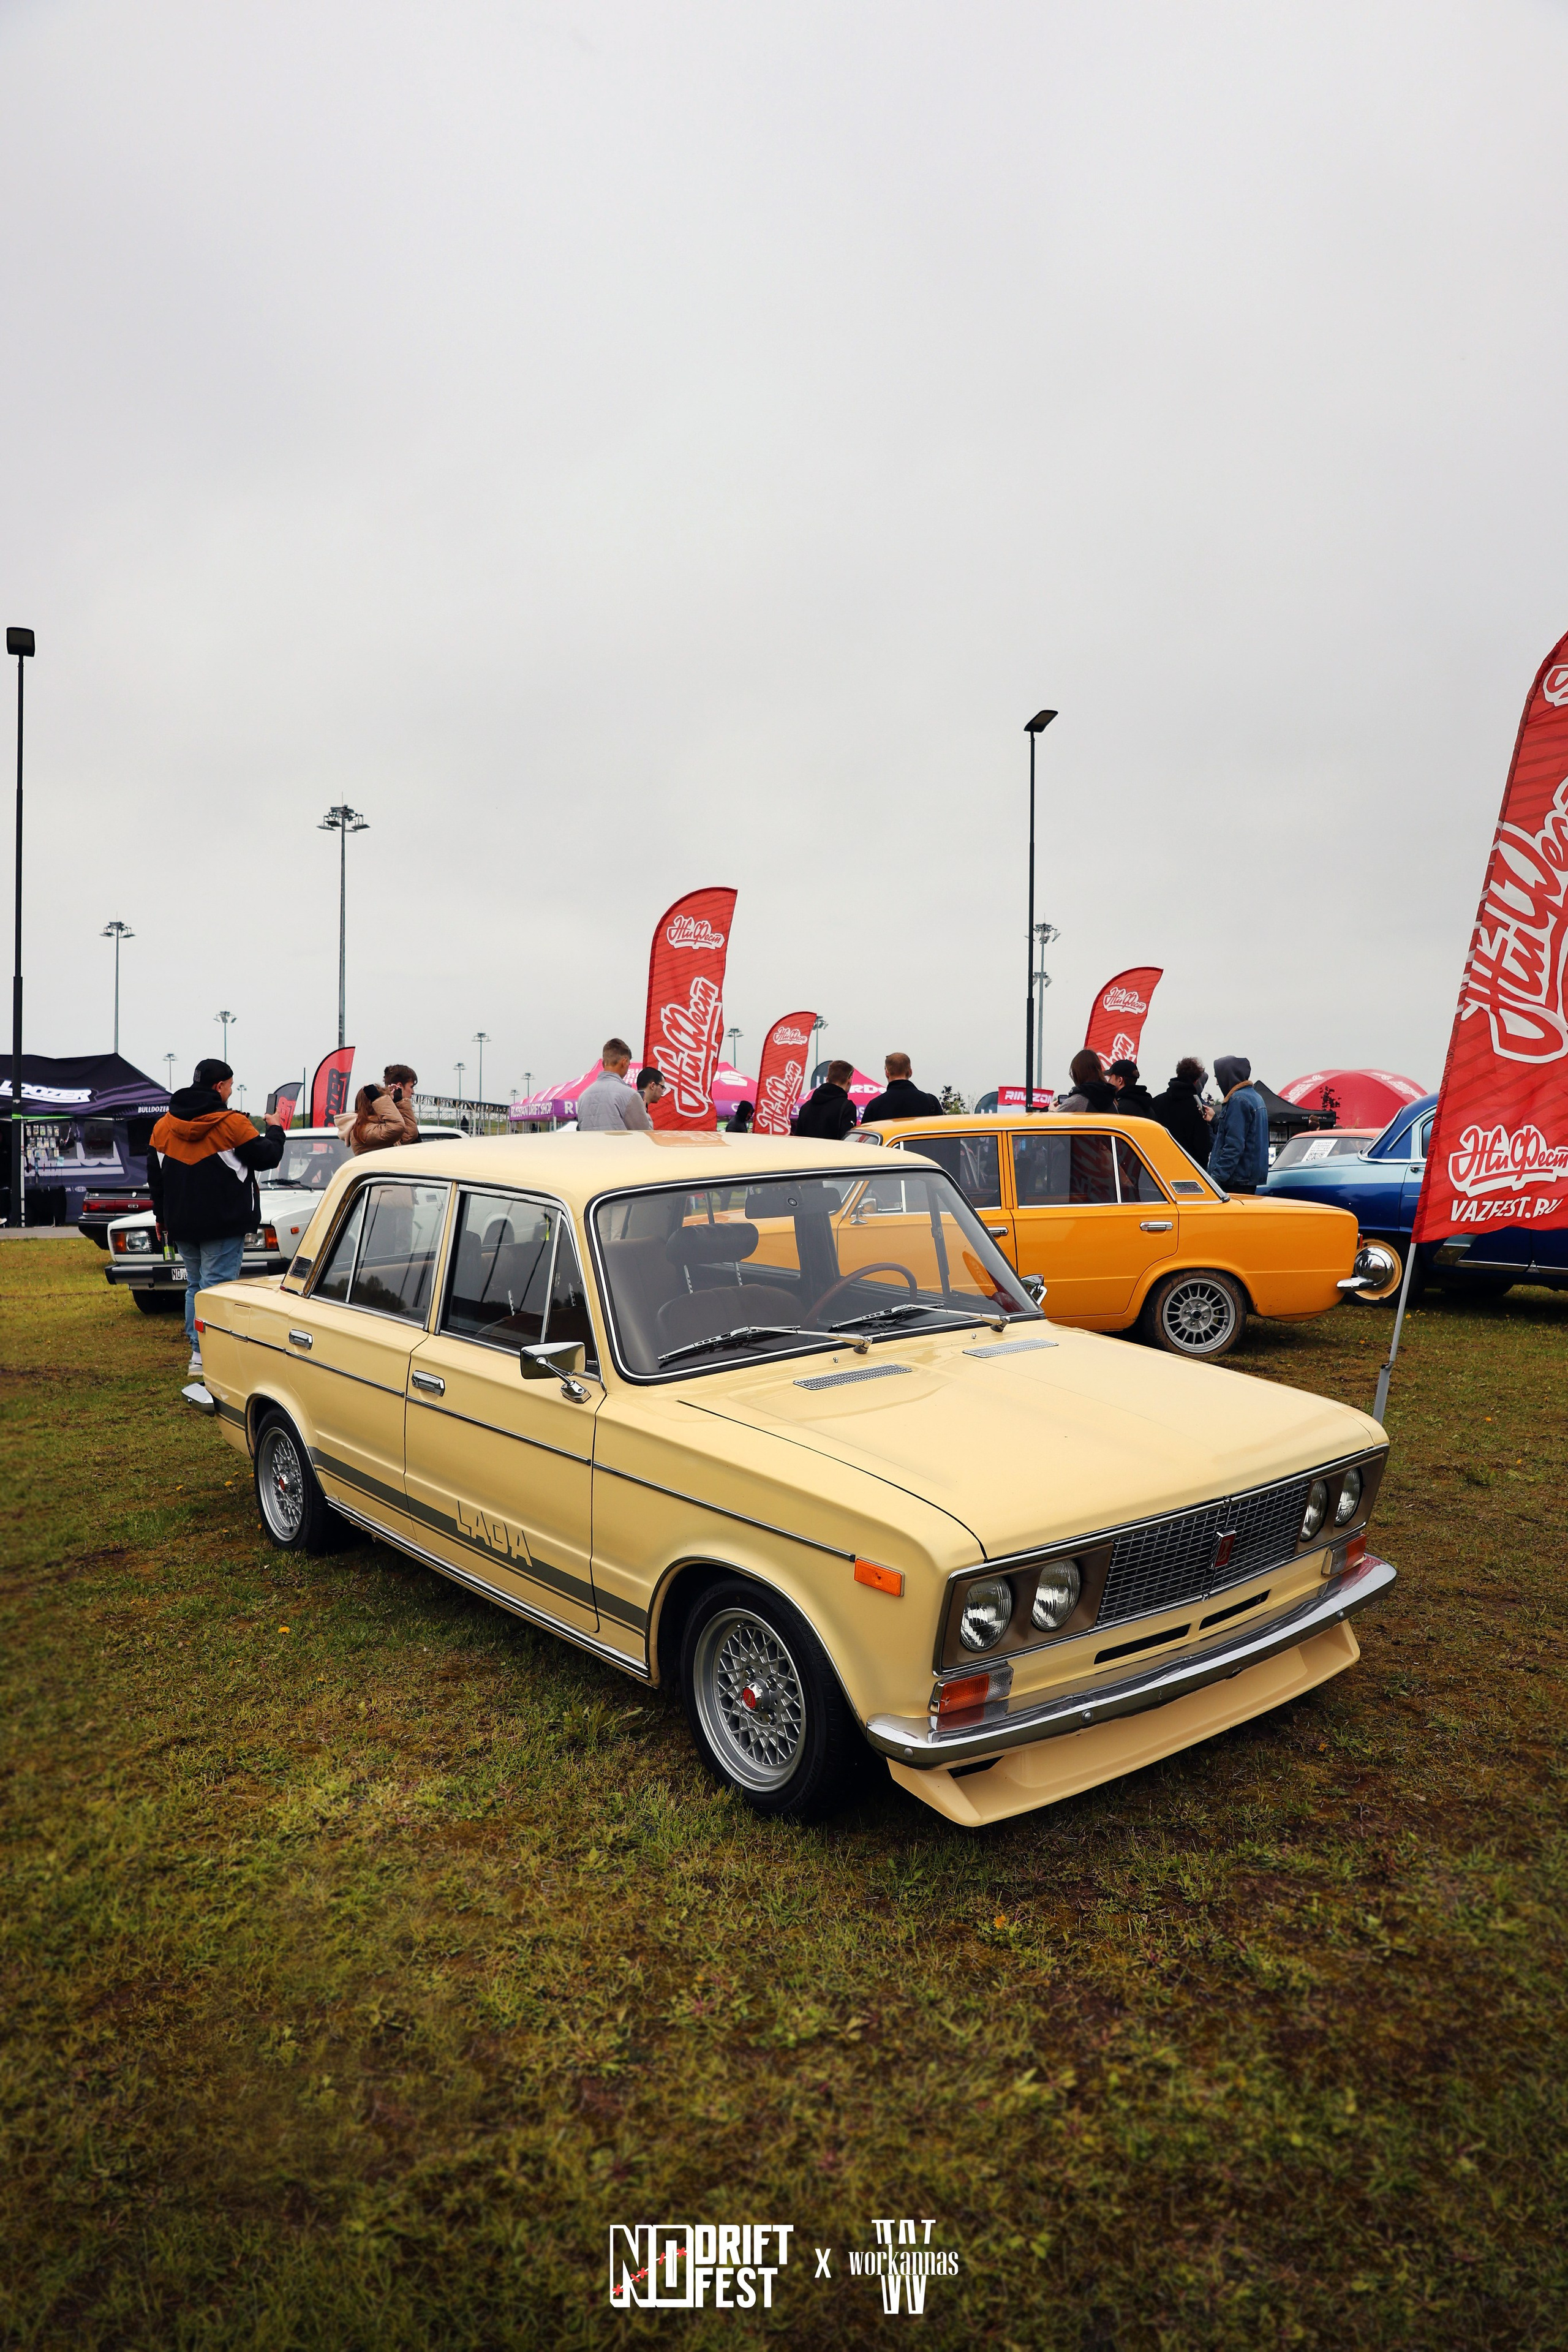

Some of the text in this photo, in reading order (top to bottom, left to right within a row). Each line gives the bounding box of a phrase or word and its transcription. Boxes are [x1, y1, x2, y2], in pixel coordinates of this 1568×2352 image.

[529, 1103, 541, 1116] DRIFT
[1450, 1197, 1564, 1222] VAZFEST.RU
[456, 1500, 533, 1567] LADA
